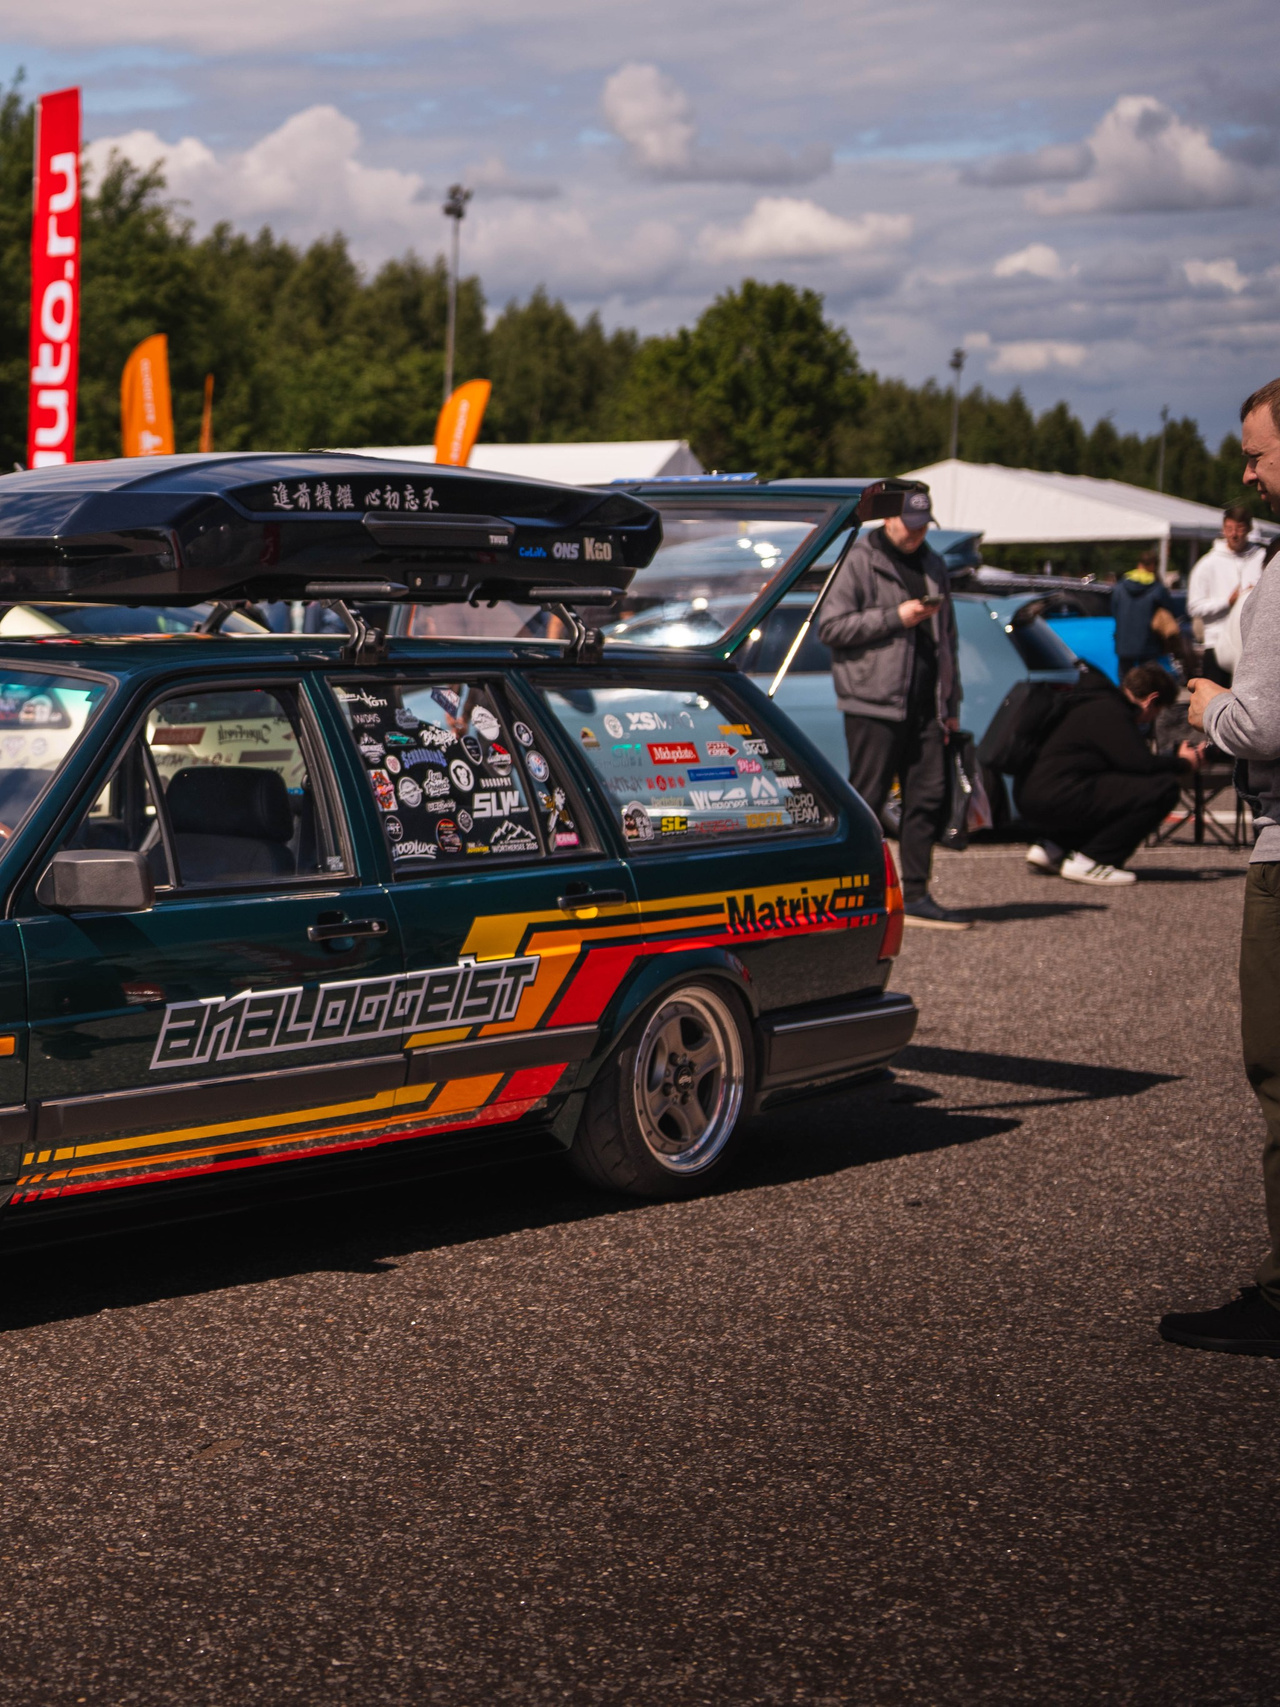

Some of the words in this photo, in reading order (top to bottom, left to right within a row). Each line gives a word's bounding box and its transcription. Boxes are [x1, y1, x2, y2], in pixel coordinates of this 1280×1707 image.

[489, 535, 509, 545] THULE
[552, 541, 580, 560] ONS
[775, 775, 802, 788] THULE
[473, 790, 519, 818] SLW
[789, 805, 820, 823] TEAM
[392, 840, 438, 858] HOODLUXE
[726, 887, 832, 935] Matrix
